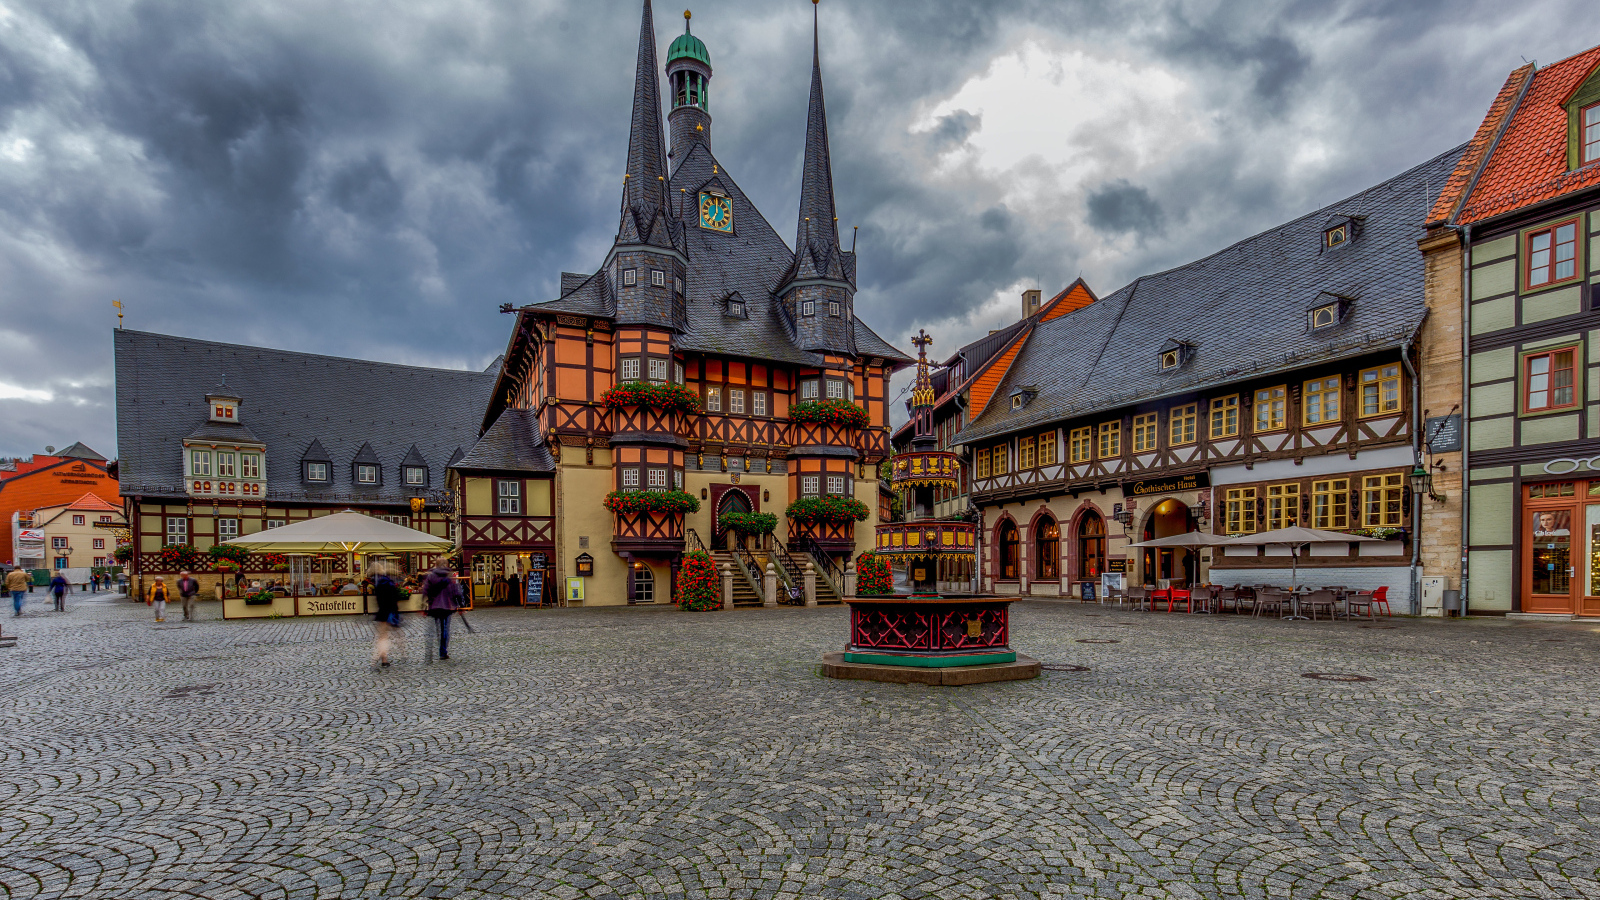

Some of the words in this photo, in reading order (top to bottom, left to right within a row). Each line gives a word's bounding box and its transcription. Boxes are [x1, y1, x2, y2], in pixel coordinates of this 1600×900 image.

[1133, 481, 1176, 494] Gothisches
[1178, 481, 1197, 490] Haus
[307, 600, 356, 611] Ratskeller
